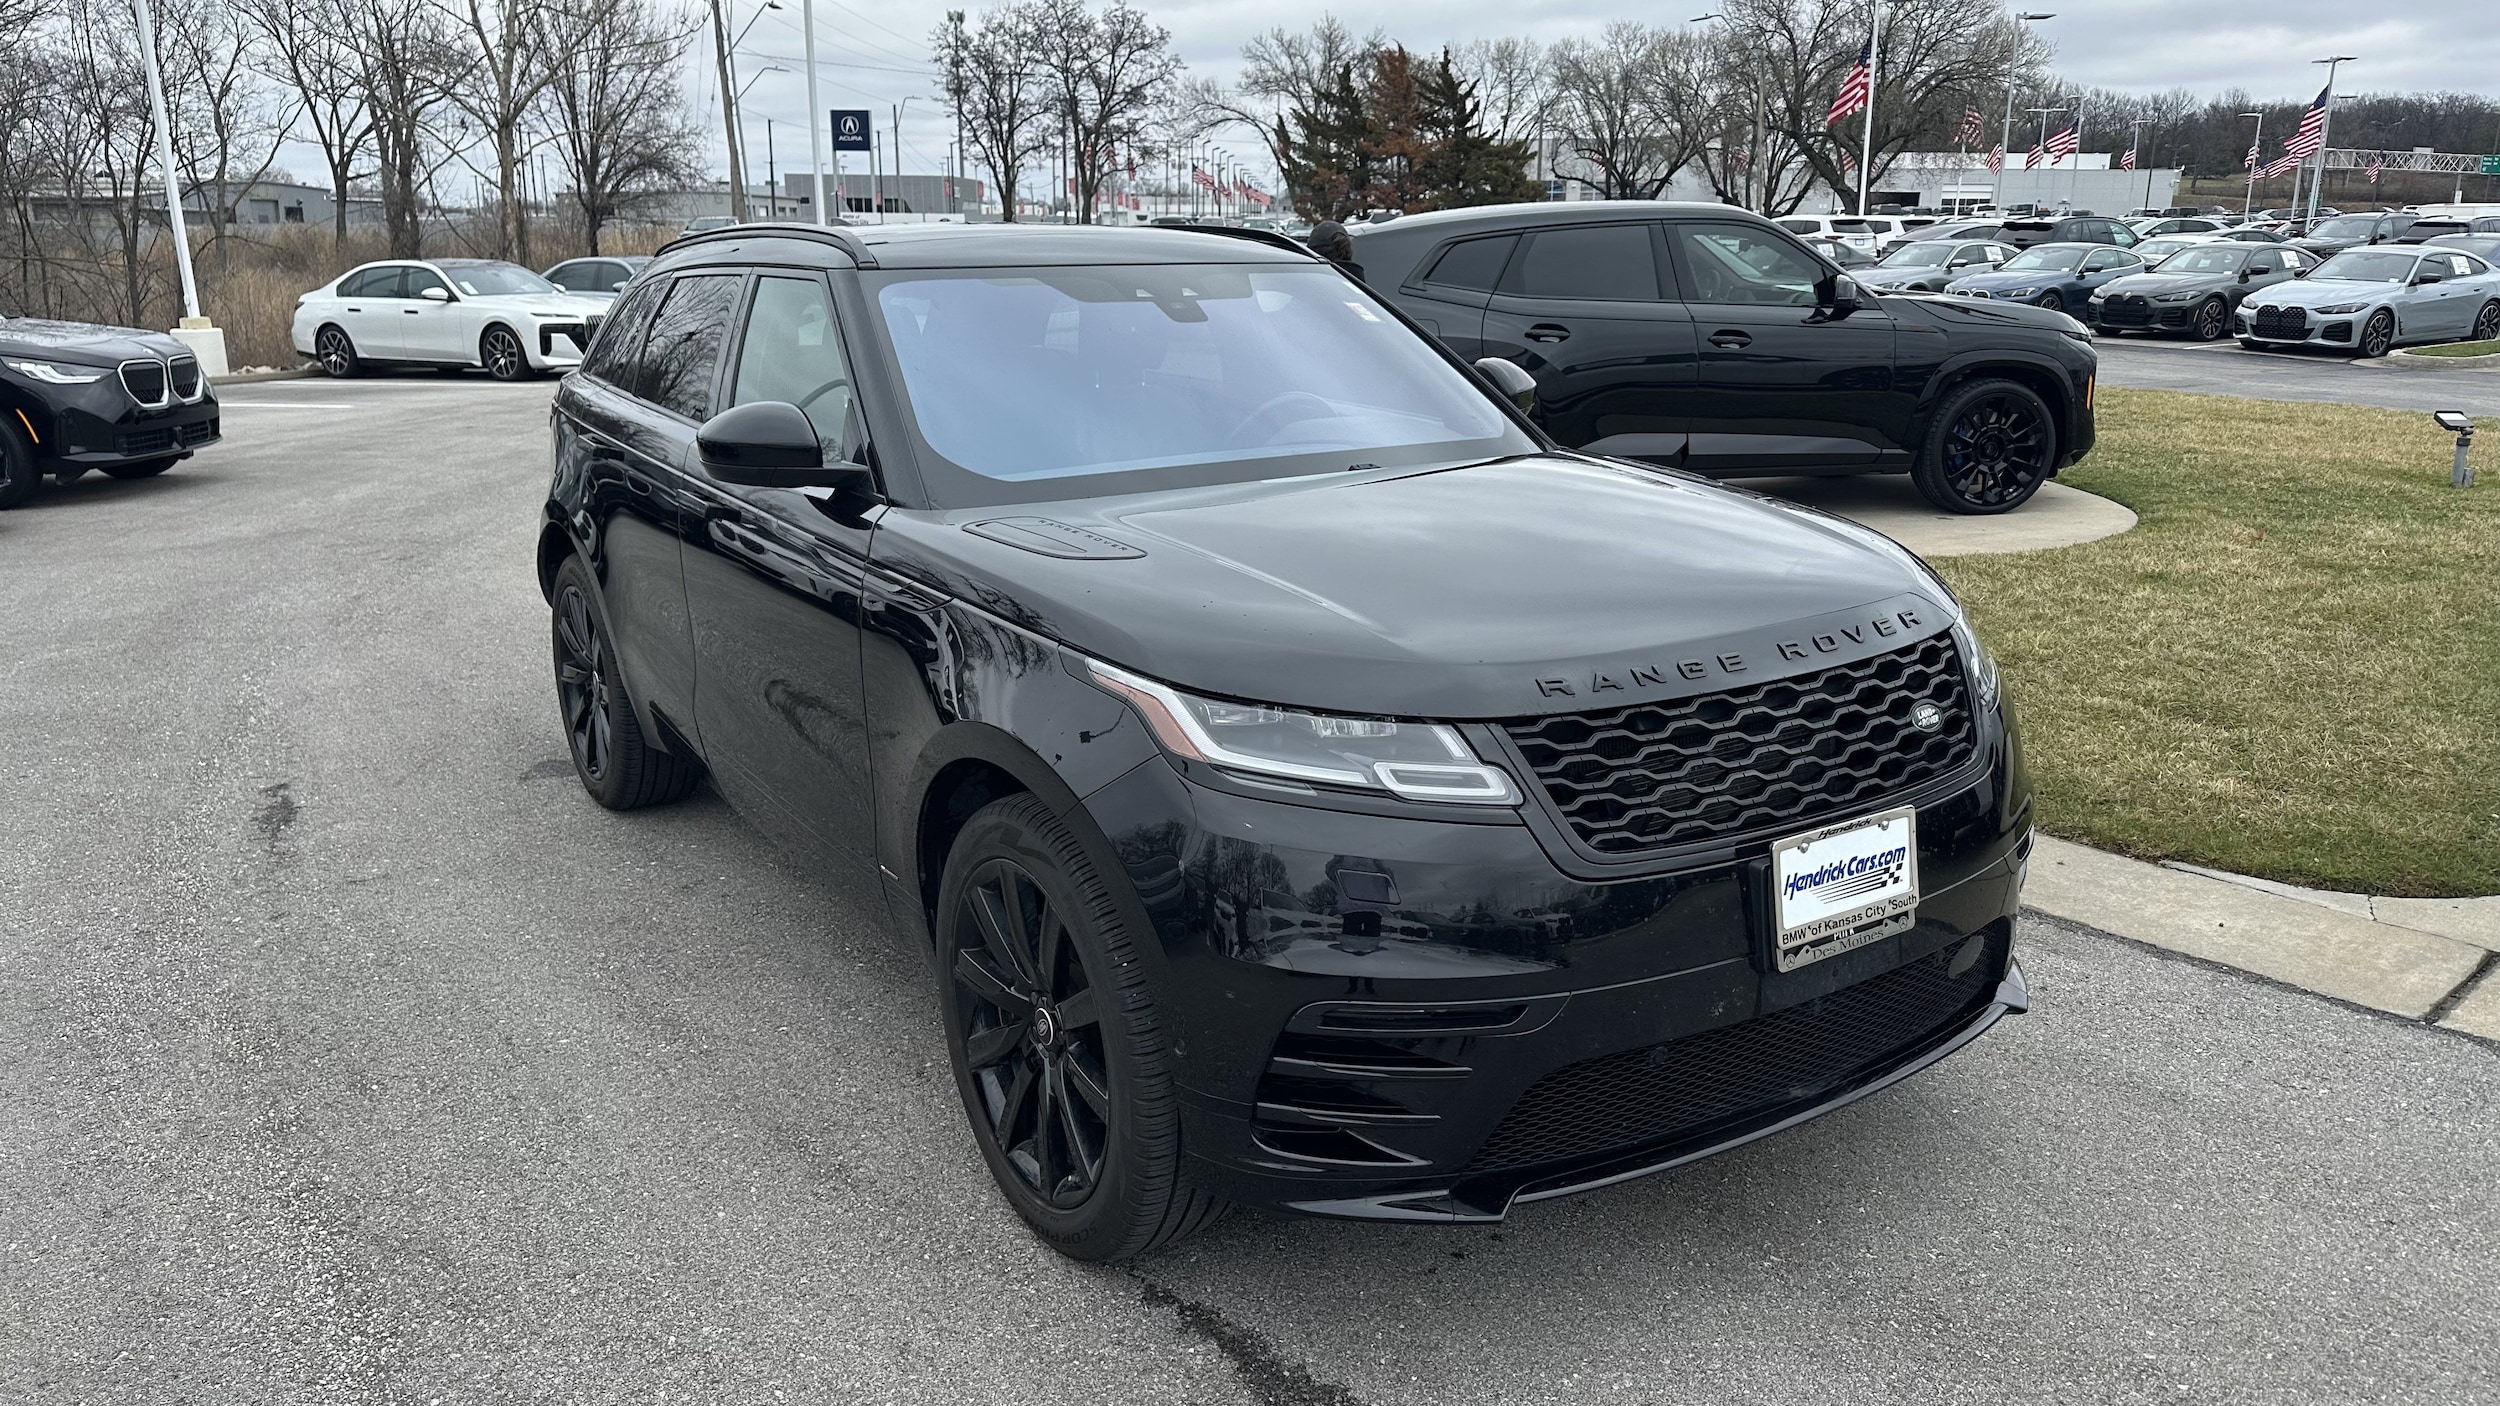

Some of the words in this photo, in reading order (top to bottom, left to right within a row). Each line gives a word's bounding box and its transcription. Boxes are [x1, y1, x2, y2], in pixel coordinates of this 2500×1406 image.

[1038, 519, 1079, 535] RANGE
[1084, 534, 1129, 551] ROVER
[1535, 651, 1749, 698] RANGE
[1776, 609, 1923, 662] ROVER
[1818, 818, 1872, 839] Hendrick
[1782, 927, 1807, 945] BMW
[1811, 925, 1822, 935] of
[1824, 912, 1863, 931] Kansas
[1865, 904, 1887, 919] City
[1891, 894, 1917, 909] South
[1812, 944, 1836, 960] Des
[1840, 929, 1884, 949] Moines
